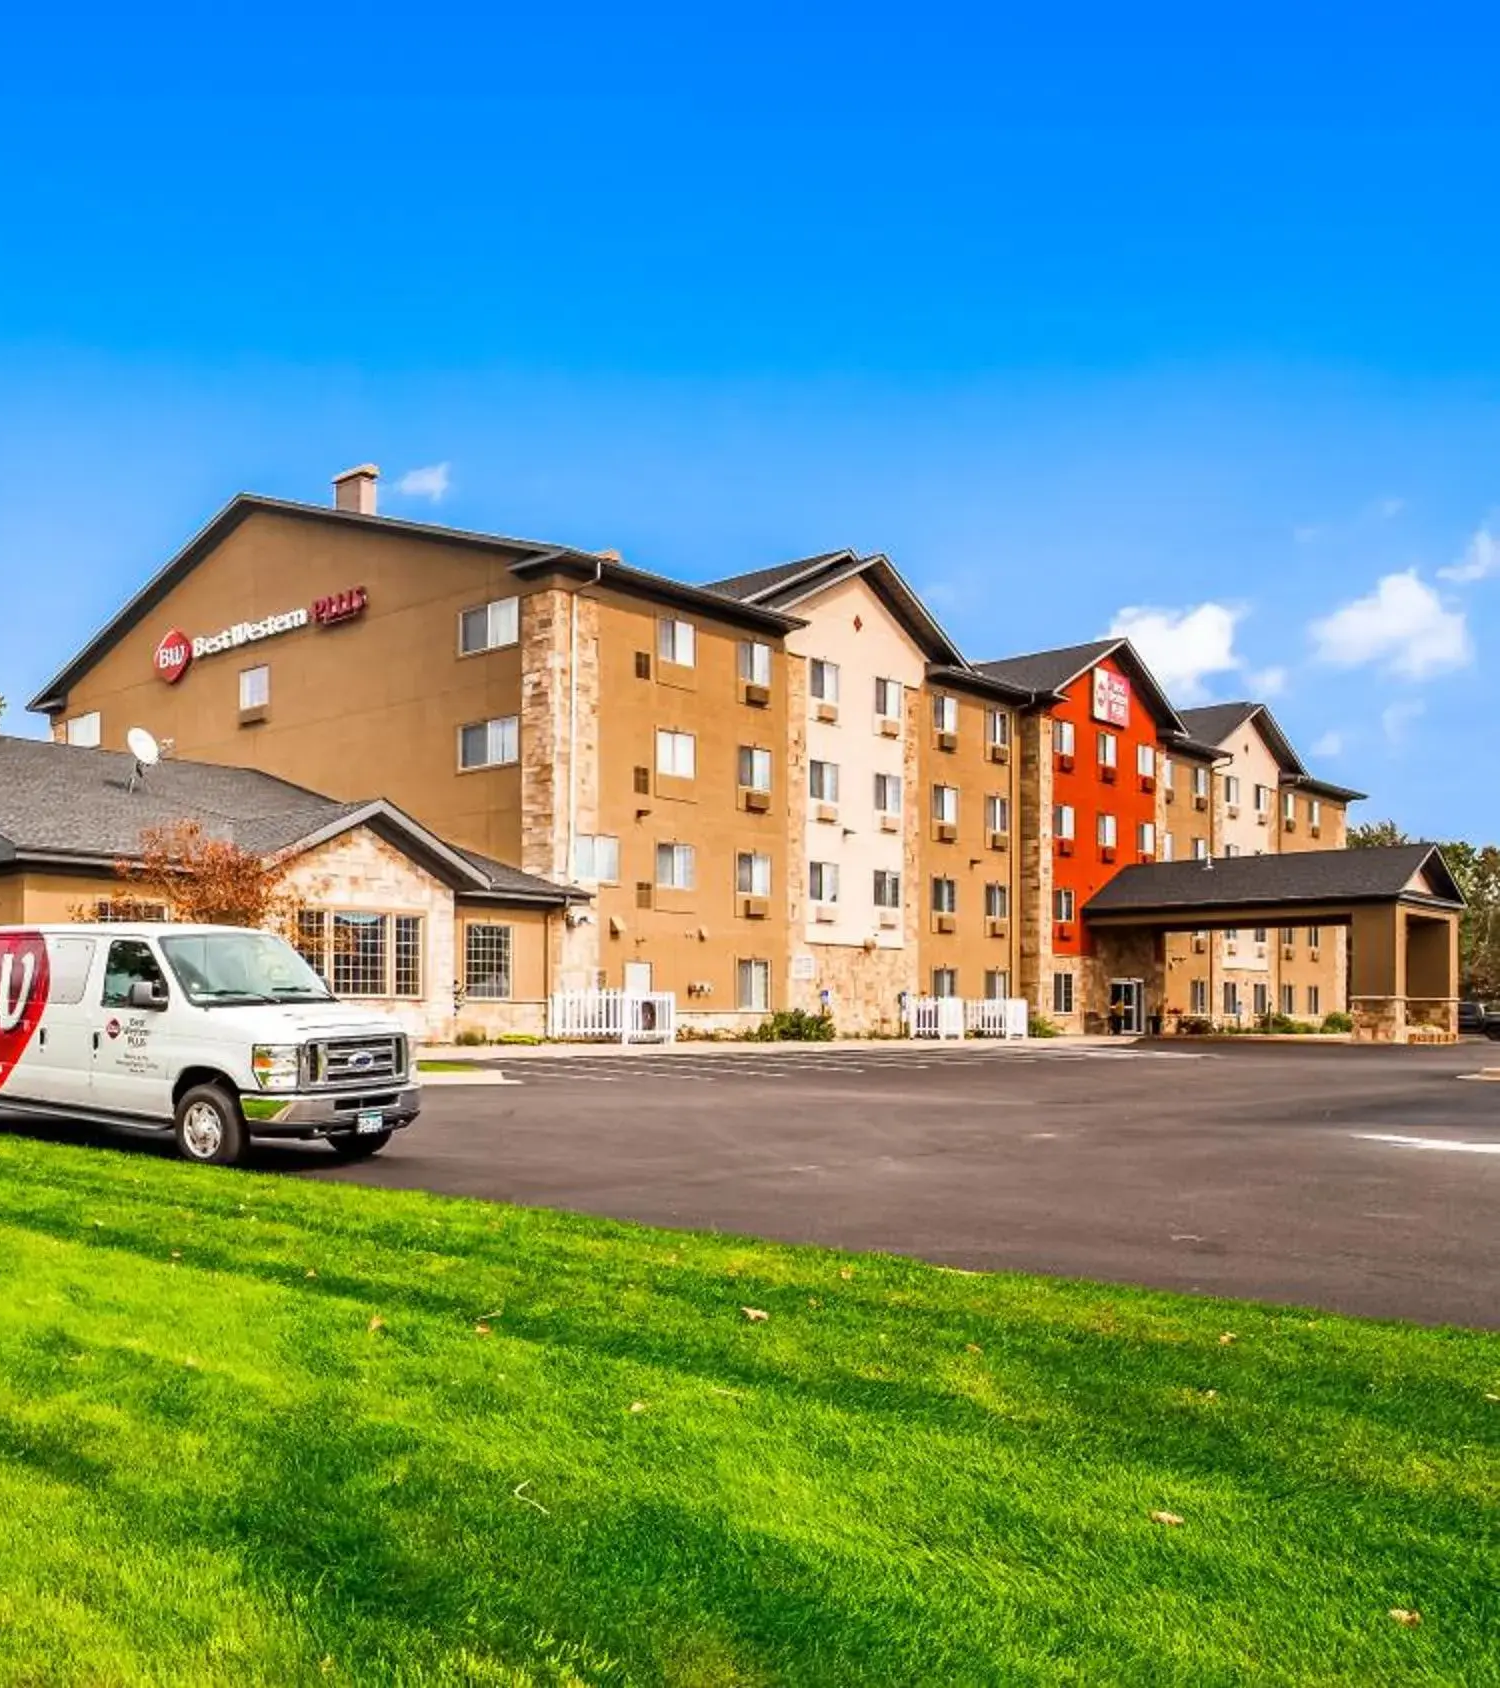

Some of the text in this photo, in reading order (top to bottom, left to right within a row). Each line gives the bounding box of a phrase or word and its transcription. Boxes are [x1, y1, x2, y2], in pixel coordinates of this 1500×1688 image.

[192, 630, 232, 659] Best
[230, 607, 308, 646] Western
[159, 645, 186, 669] BW
